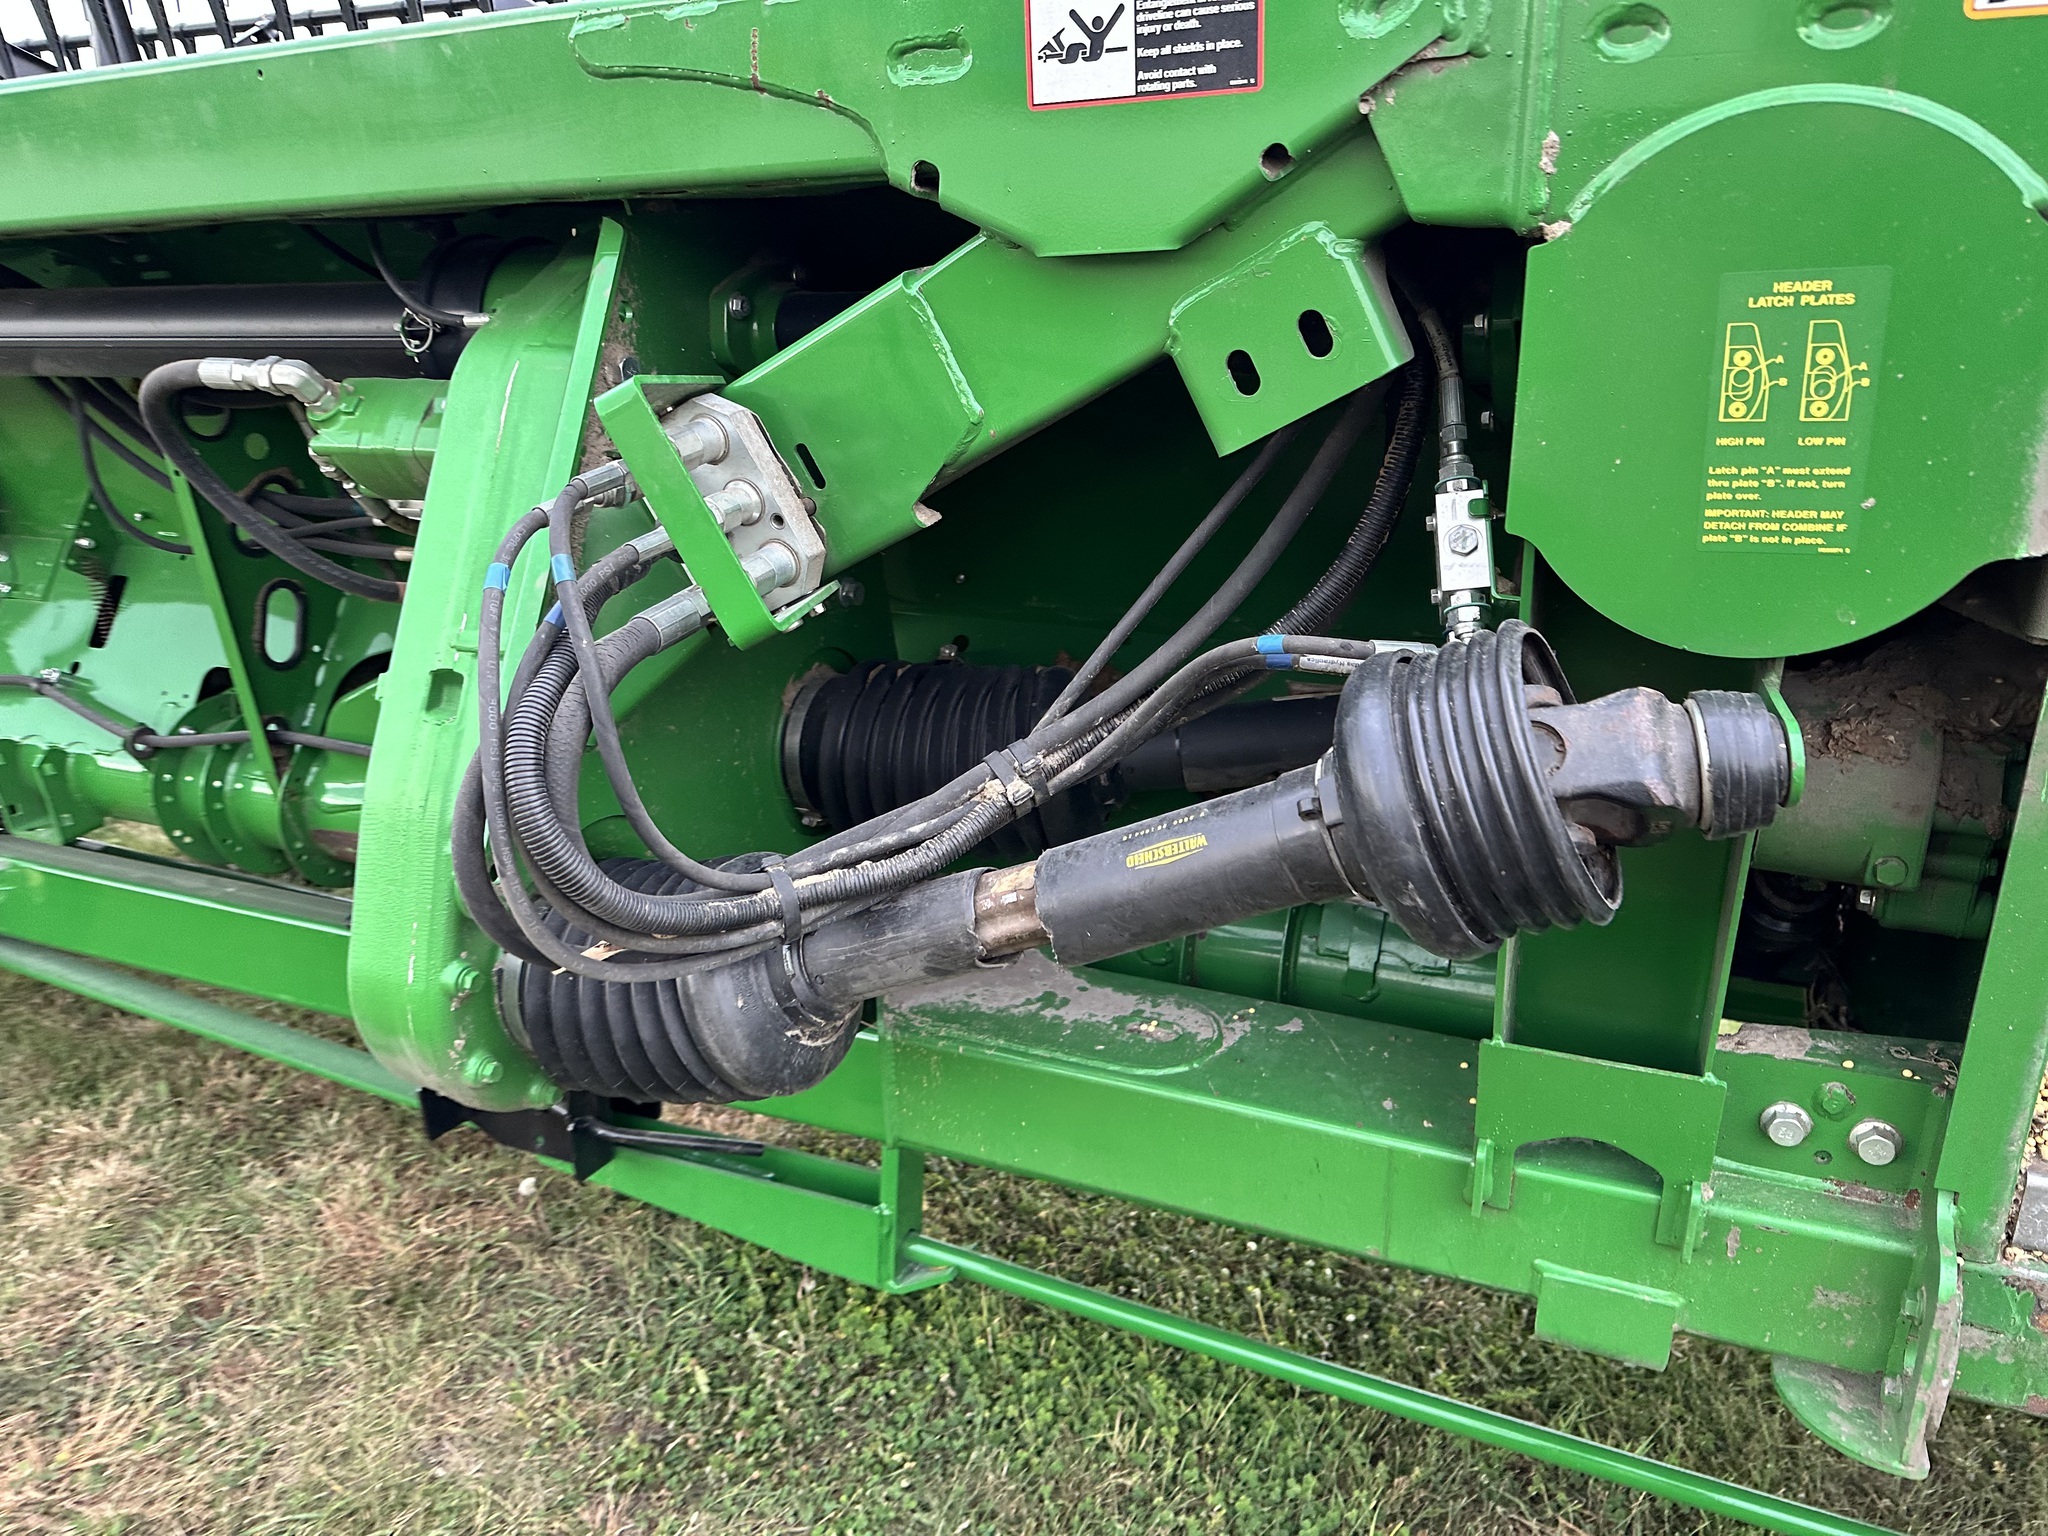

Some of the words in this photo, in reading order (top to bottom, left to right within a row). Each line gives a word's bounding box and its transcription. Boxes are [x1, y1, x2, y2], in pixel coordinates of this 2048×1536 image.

[1136, 10, 1174, 22] driveline
[1175, 8, 1192, 18] can
[1192, 5, 1220, 16] cause
[1220, 1, 1255, 13] serious
[1136, 24, 1162, 36] injury
[1162, 22, 1174, 32] or
[1173, 18, 1202, 30] death.
[1136, 47, 1160, 58] Keep
[1160, 44, 1172, 55] all
[1172, 41, 1205, 54] shields
[1205, 41, 1215, 51] in
[1215, 39, 1243, 52] place.
[1137, 69, 1163, 81] Avoid
[1163, 66, 1196, 78] contact
[1197, 64, 1217, 75] with
[1137, 81, 1171, 93] rotating
[1172, 79, 1197, 92] parts.
[1773, 280, 1833, 293] HEADER
[1748, 295, 1795, 308] LATCH
[1800, 293, 1856, 306] PLATES
[1716, 437, 1744, 446] HIGH
[1745, 437, 1765, 446] PIN
[1797, 437, 1824, 446] LOW
[1826, 437, 1846, 446] PIN
[1708, 466, 1738, 475] Latch
[1740, 466, 1759, 476] pin
[1782, 467, 1810, 475] must
[1812, 466, 1851, 476] extend
[1707, 479, 1730, 487] thru
[1731, 479, 1759, 489] plate
[1797, 480, 1820, 489] not,
[1822, 480, 1845, 488] turn
[1706, 492, 1733, 501] plate
[1735, 493, 1762, 501] over.
[1704, 508, 1770, 518] IMPORTANT:
[1771, 510, 1818, 519] HEADER
[1820, 510, 1845, 519] MAY
[1703, 521, 1746, 530] DETACH
[1748, 522, 1780, 531] FROM
[1782, 523, 1834, 532] COMBINE
[1836, 523, 1848, 532] IF
[1702, 534, 1728, 544] plate
[1749, 535, 1760, 543] is
[1761, 535, 1779, 543] not
[1781, 535, 1792, 544] in
[1794, 535, 1826, 545] place.
[1126, 834, 1208, 868] WALTERSCHEID
